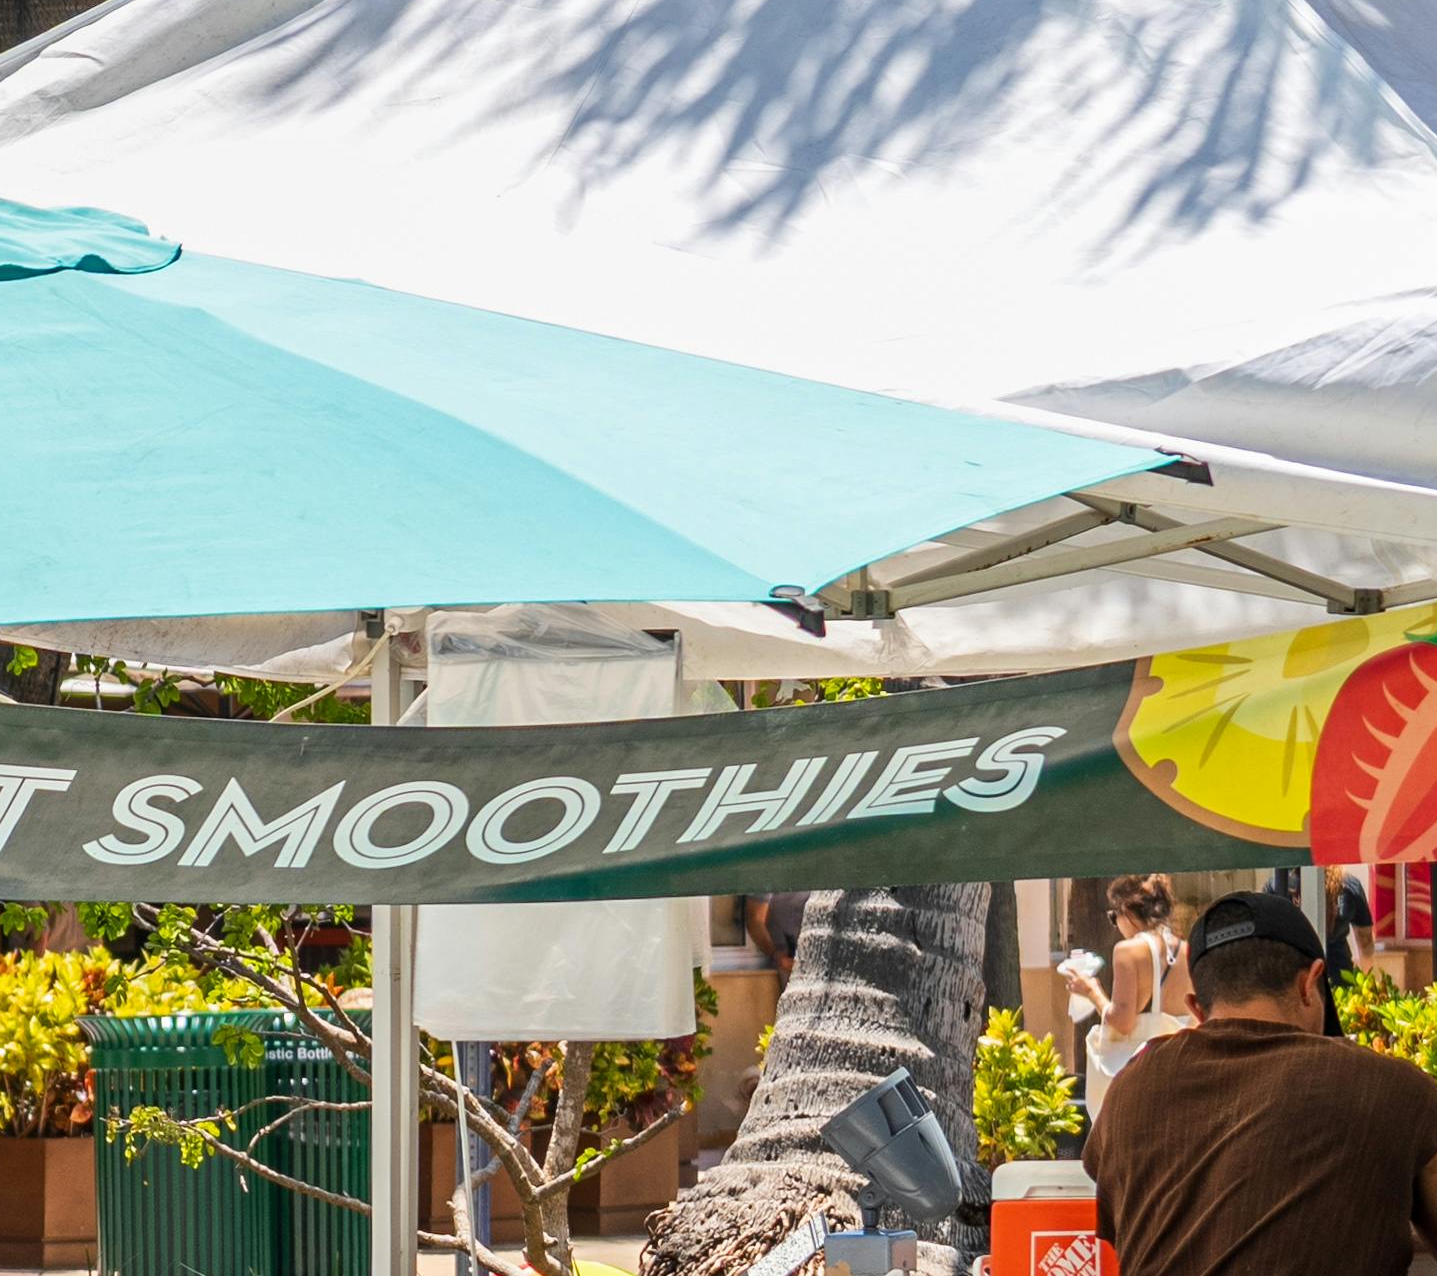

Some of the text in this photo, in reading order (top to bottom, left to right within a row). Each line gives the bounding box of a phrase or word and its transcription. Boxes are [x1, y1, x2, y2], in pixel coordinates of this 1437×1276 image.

[82, 726, 1068, 870] SMOOTHIES
[265, 1047, 294, 1060] stic
[1038, 1242, 1065, 1272] THE
